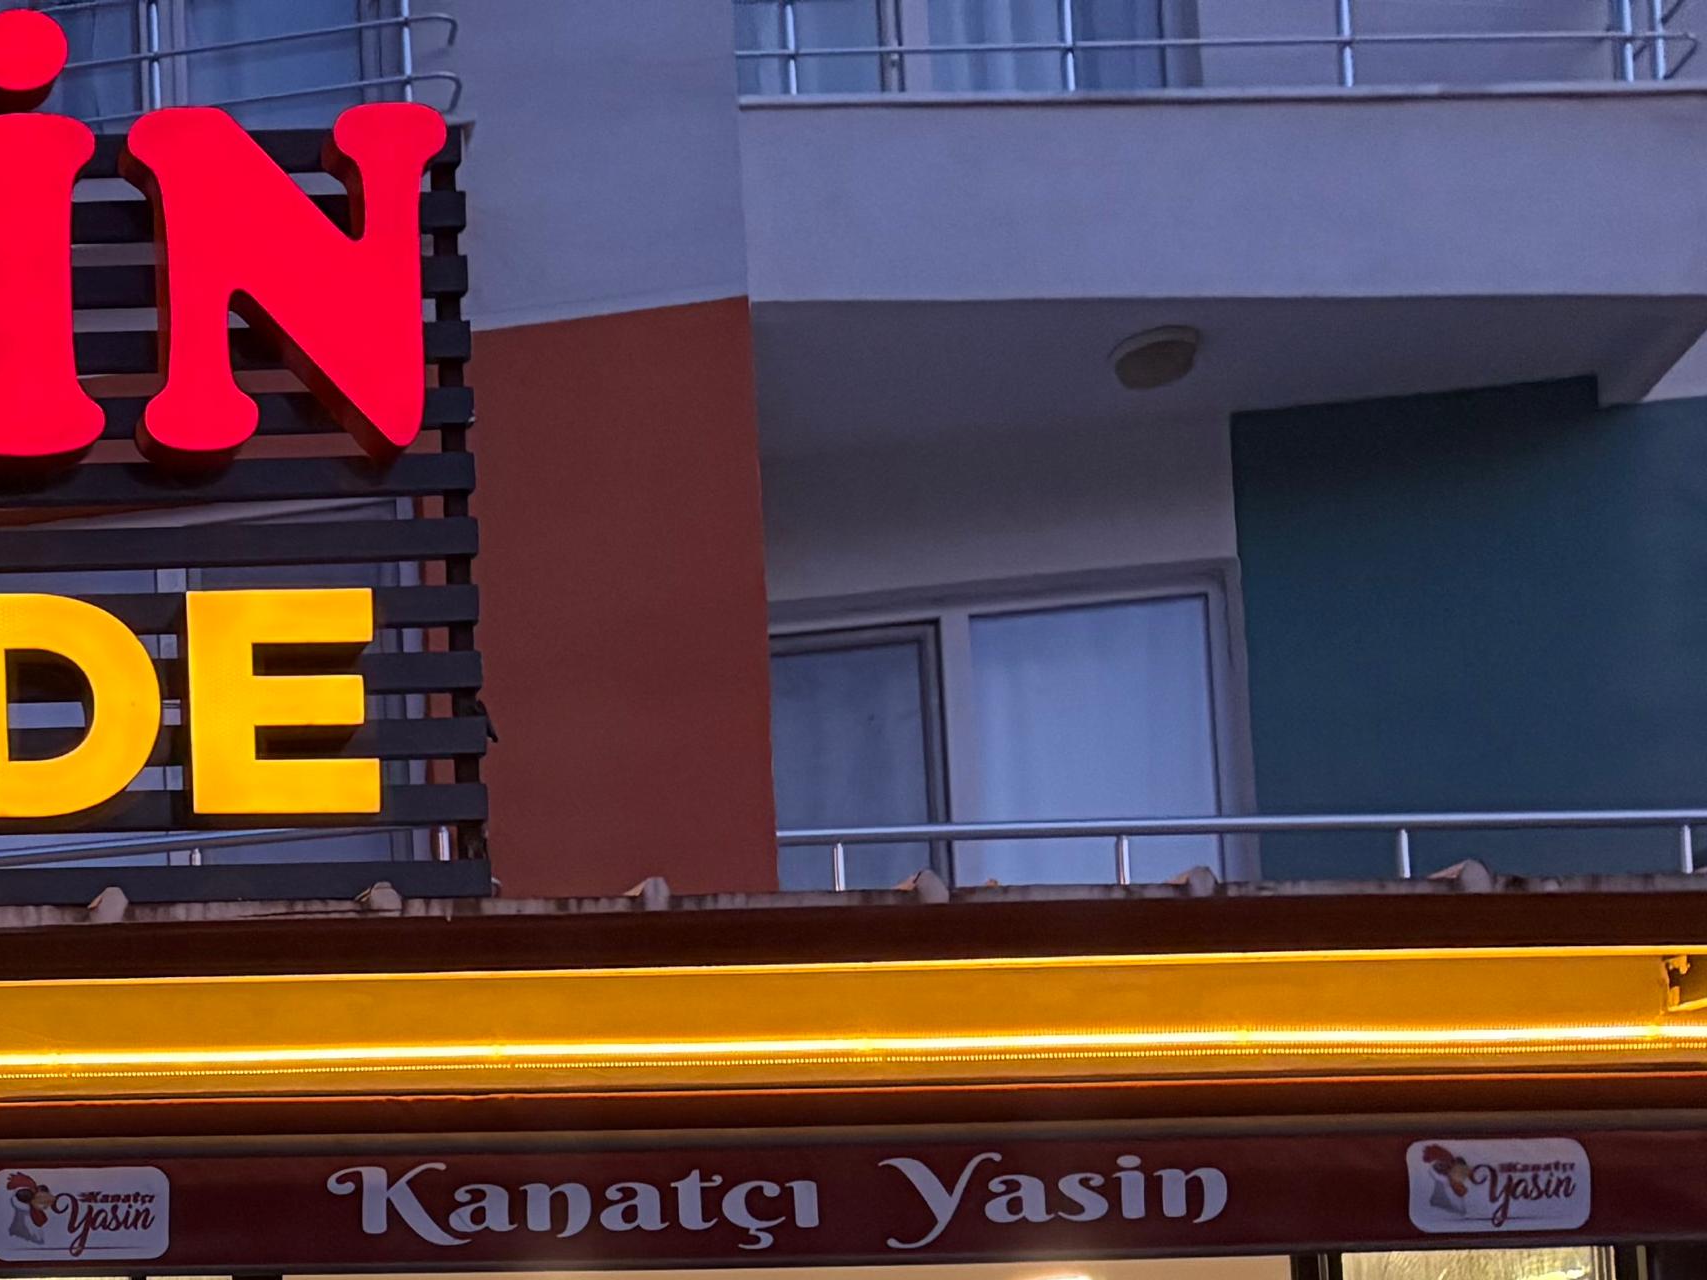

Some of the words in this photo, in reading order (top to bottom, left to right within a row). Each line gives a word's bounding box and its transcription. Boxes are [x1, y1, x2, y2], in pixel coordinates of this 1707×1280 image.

[51, 1193, 155, 1257] Yasin
[327, 1160, 819, 1250] Kanatçı
[879, 1153, 1229, 1250] Yasin
[1469, 1164, 1577, 1228] Yasin
